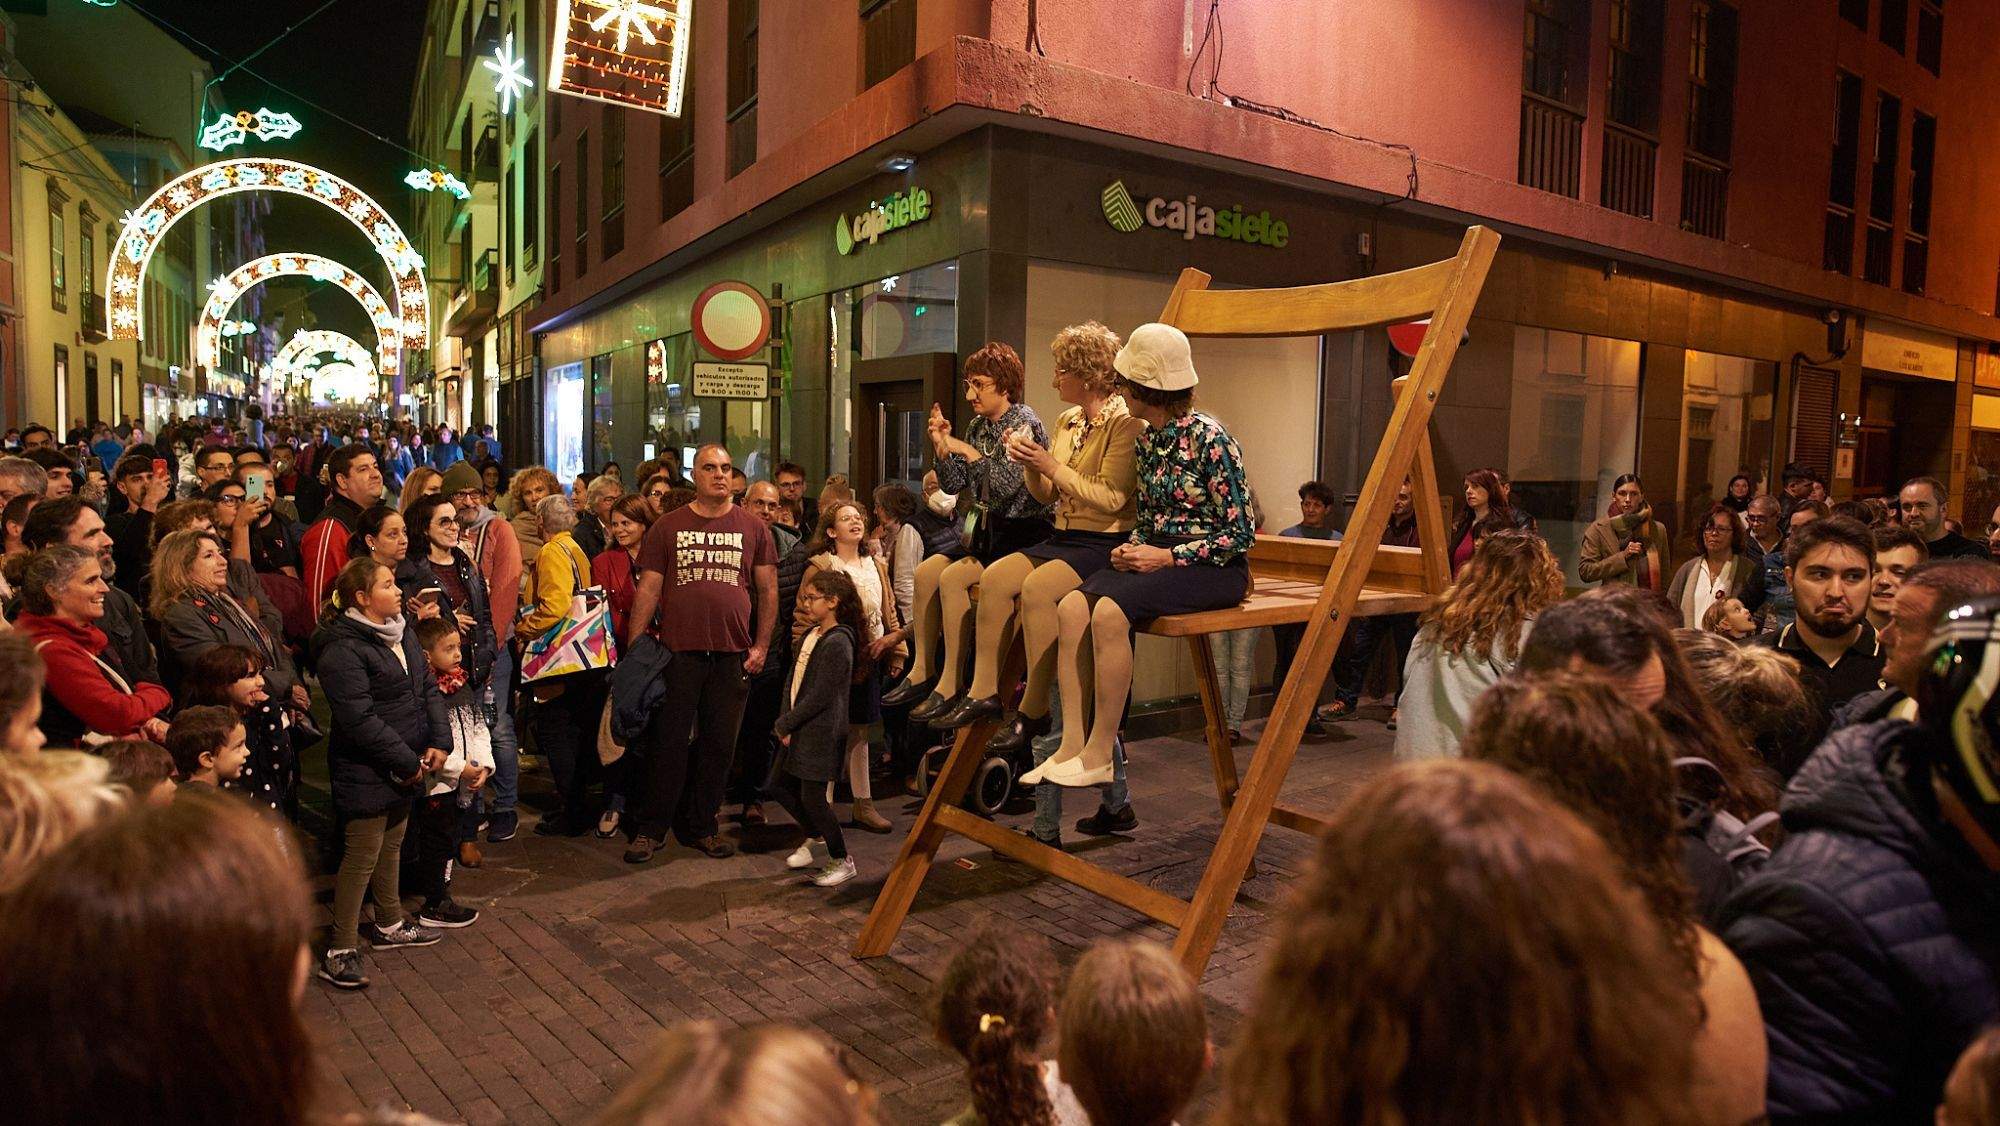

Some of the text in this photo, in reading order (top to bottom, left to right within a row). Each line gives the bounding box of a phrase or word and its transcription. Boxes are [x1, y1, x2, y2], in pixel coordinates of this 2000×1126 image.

[853, 186, 931, 245] cajasiete
[1146, 195, 1289, 248] cajasiete
[718, 366, 744, 374] Excepto
[728, 374, 765, 382] autorizados
[676, 531, 744, 550] NEW YORK
[676, 549, 743, 569] NEW YORK
[676, 568, 740, 587] NEW YORK
